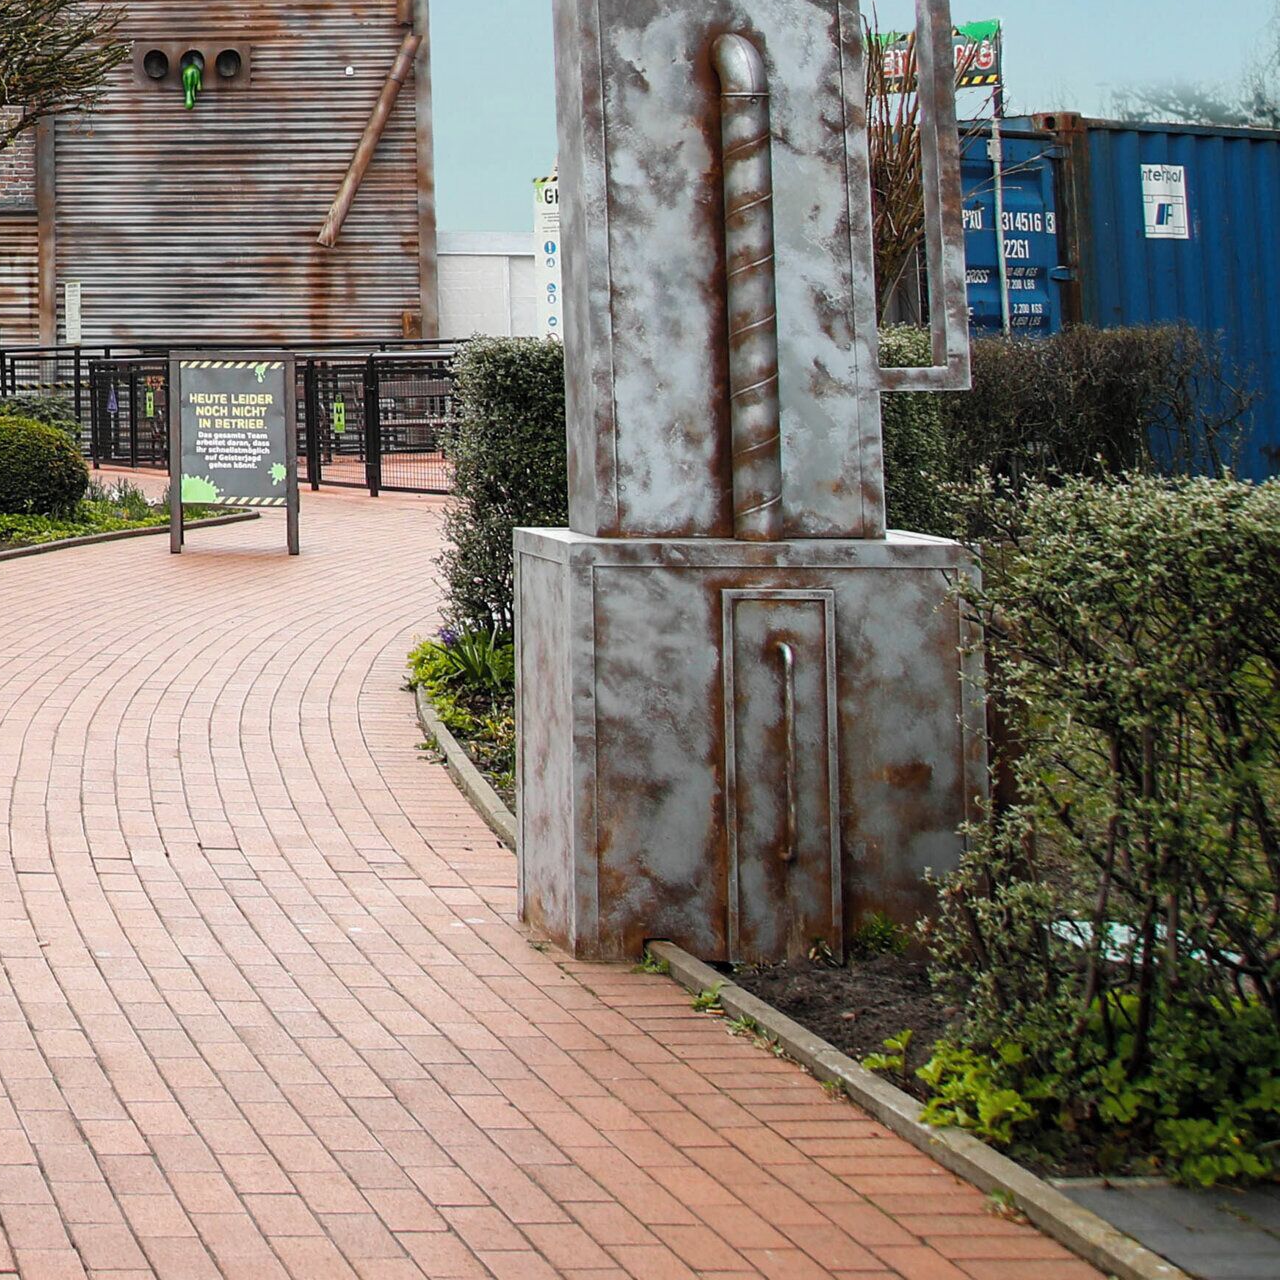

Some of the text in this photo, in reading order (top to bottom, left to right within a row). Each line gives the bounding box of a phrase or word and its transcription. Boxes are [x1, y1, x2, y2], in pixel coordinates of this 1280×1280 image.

[1001, 212, 1042, 232] 314516
[1046, 213, 1056, 232] 3
[189, 393, 274, 405] HEUTE LEIDER
[195, 406, 267, 417] NOCH NICHT
[198, 418, 268, 429] IN BETRIEB.
[198, 431, 213, 439] Das
[213, 432, 246, 440] gesamte
[196, 439, 226, 447] arbeitet
[252, 439, 270, 447] dass
[205, 454, 262, 463] auf Geisterjagd
[208, 462, 232, 470] gehen
